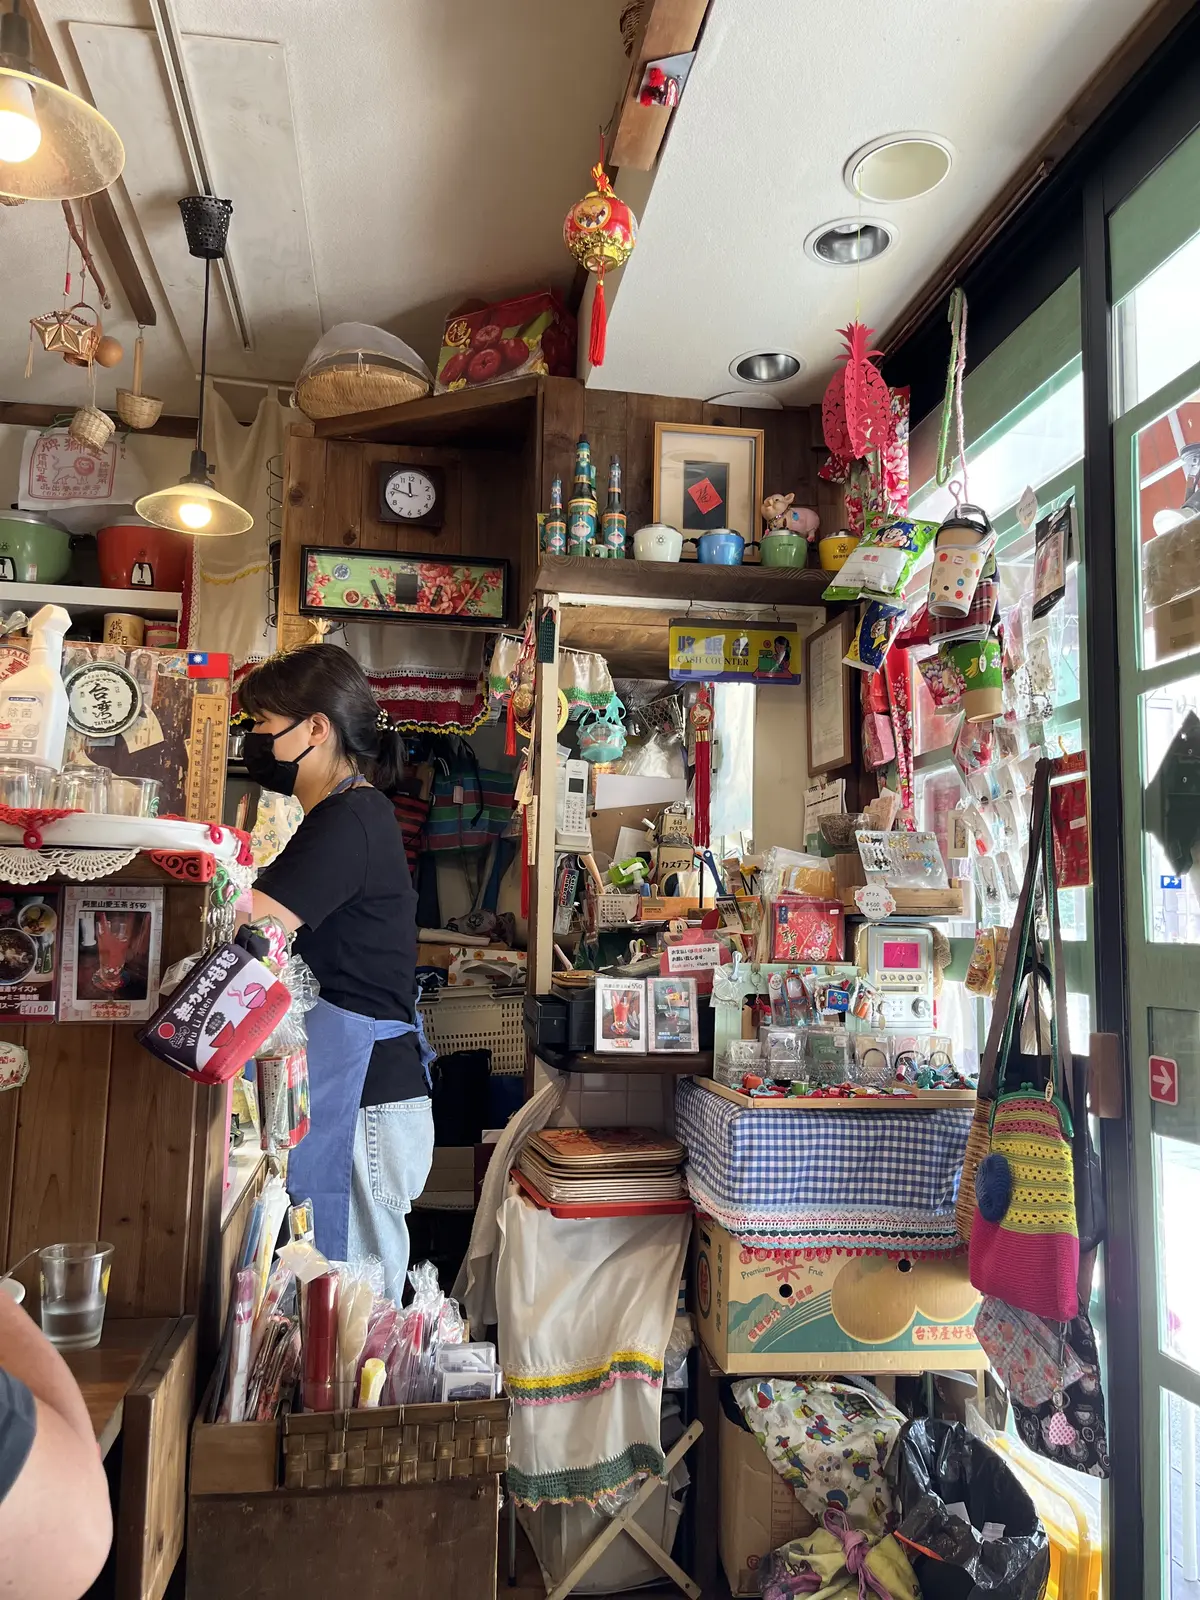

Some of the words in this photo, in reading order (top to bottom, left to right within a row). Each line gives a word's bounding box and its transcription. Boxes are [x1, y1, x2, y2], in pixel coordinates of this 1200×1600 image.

[677, 656, 702, 664] CASH
[705, 657, 749, 666] COUNTER
[84, 672, 111, 680] FORMOSA
[7, 707, 32, 719] 除菌
[661, 860, 691, 870] カステラ
[186, 1035, 198, 1047] Wu
[195, 1019, 202, 1029] Li
[200, 998, 213, 1017] Men
[740, 1266, 771, 1280] Premium
[808, 1265, 824, 1277] Fruit
